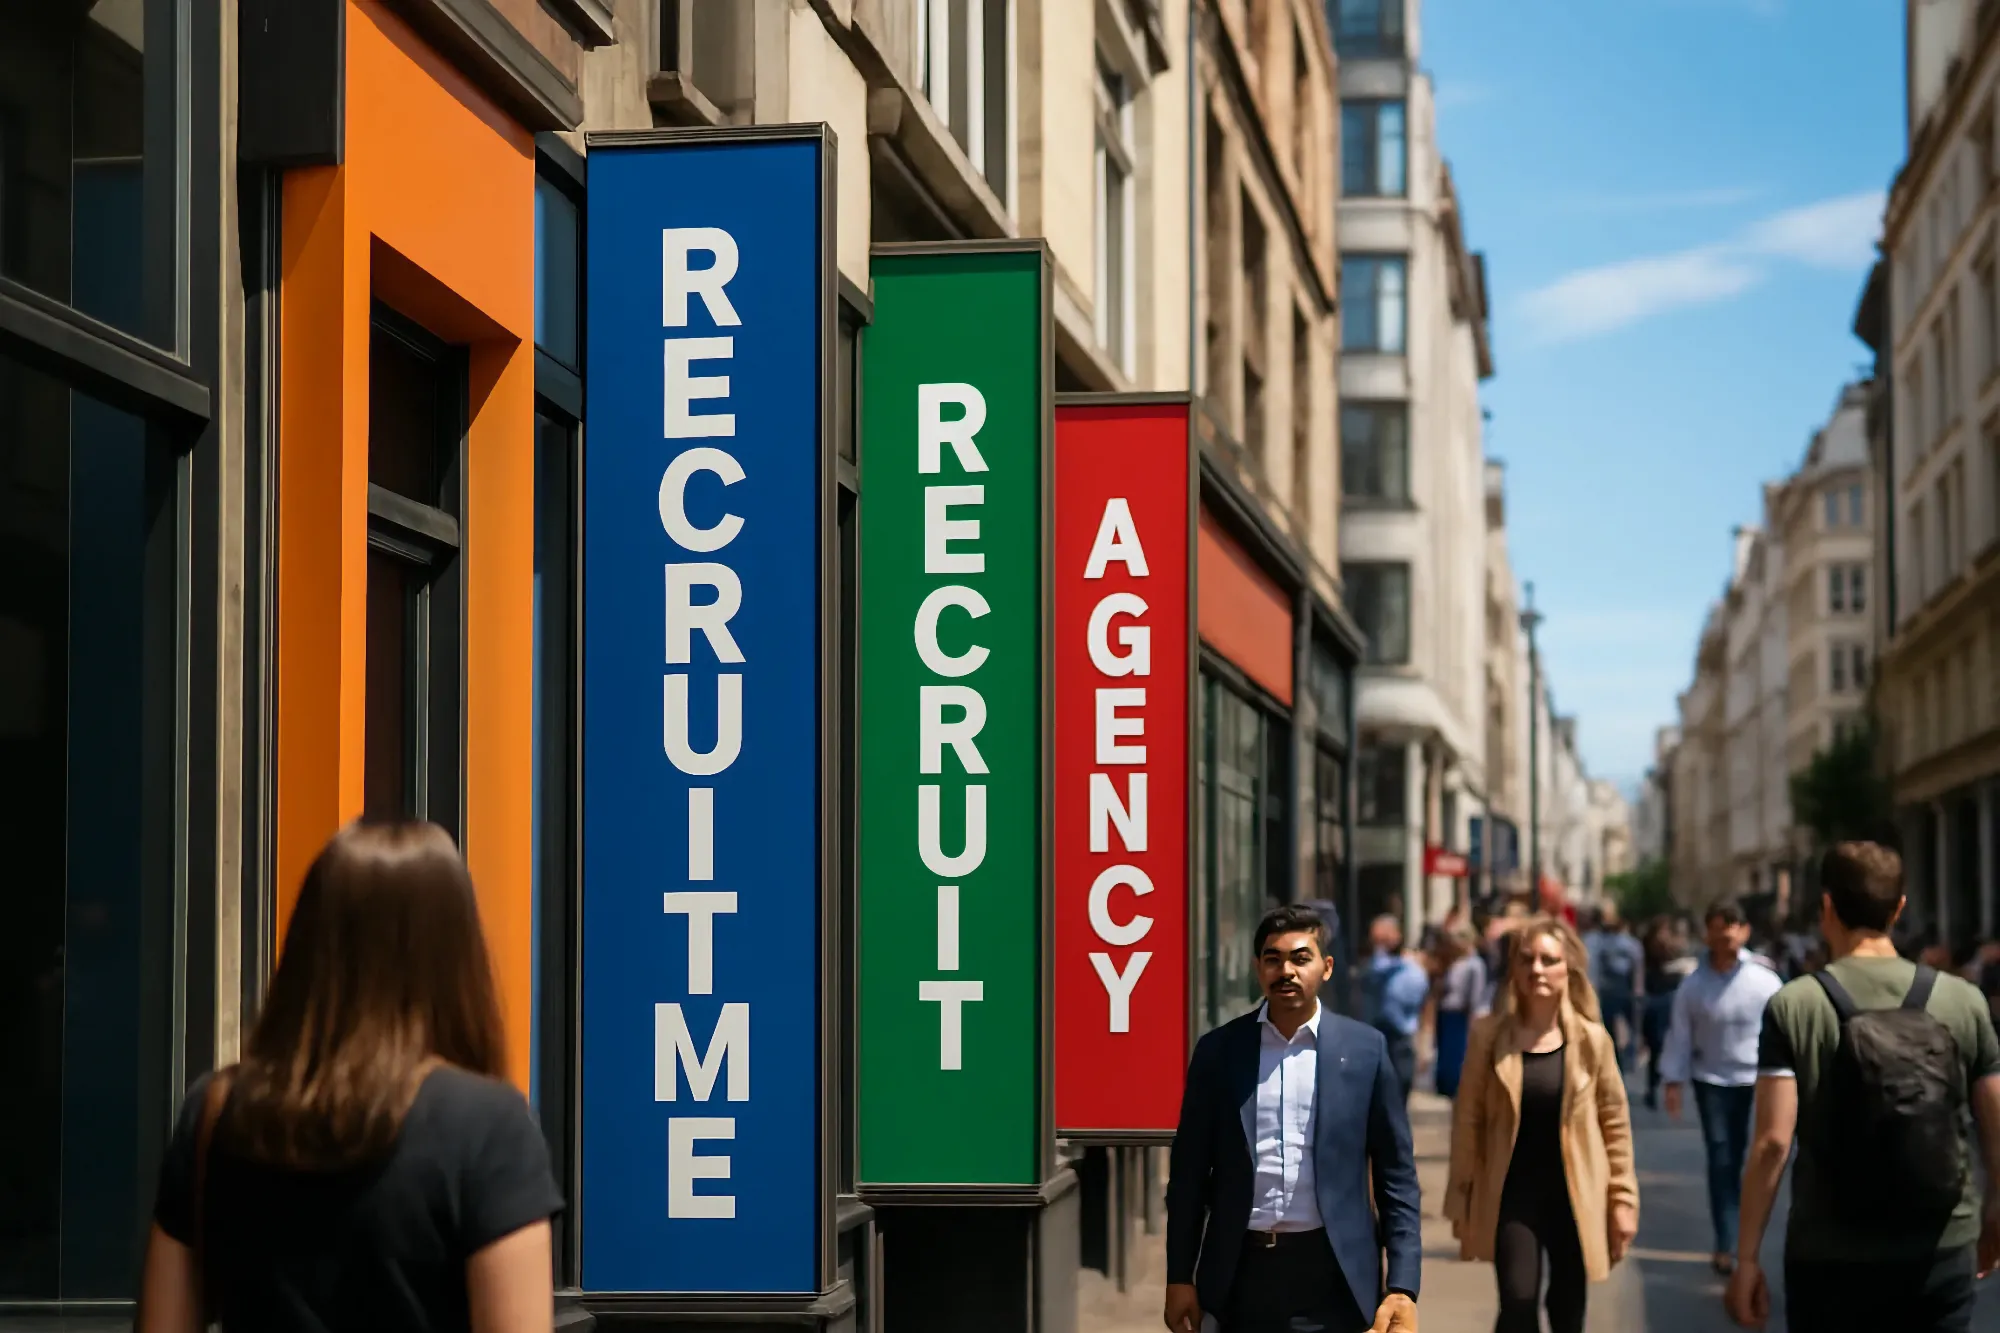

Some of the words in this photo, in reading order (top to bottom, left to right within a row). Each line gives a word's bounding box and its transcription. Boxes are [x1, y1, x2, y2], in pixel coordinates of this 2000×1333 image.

[654, 227, 750, 1219] RECRUITME
[914, 382, 991, 1070] RECRUIT
[1083, 497, 1155, 1033] AGENCY
